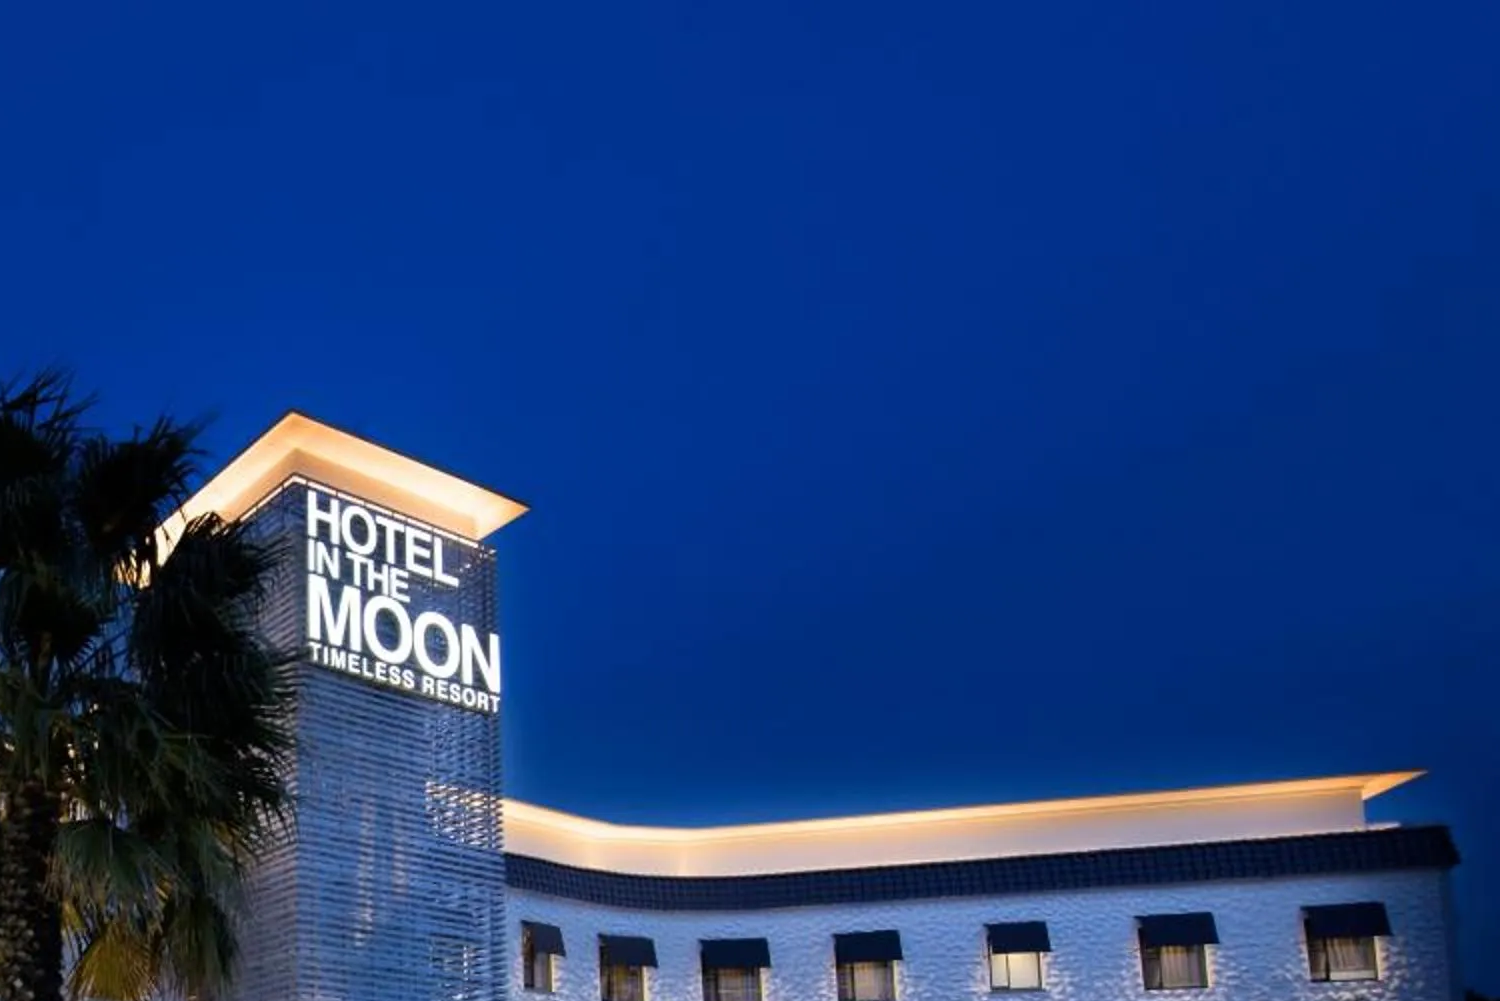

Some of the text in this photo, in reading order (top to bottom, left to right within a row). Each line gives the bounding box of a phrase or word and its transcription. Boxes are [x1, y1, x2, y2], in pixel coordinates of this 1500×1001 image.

[306, 489, 460, 588] HOTEL
[306, 538, 411, 604] IN THE
[306, 573, 501, 694] MOON
[308, 640, 501, 713] TIMELESS RESORT
